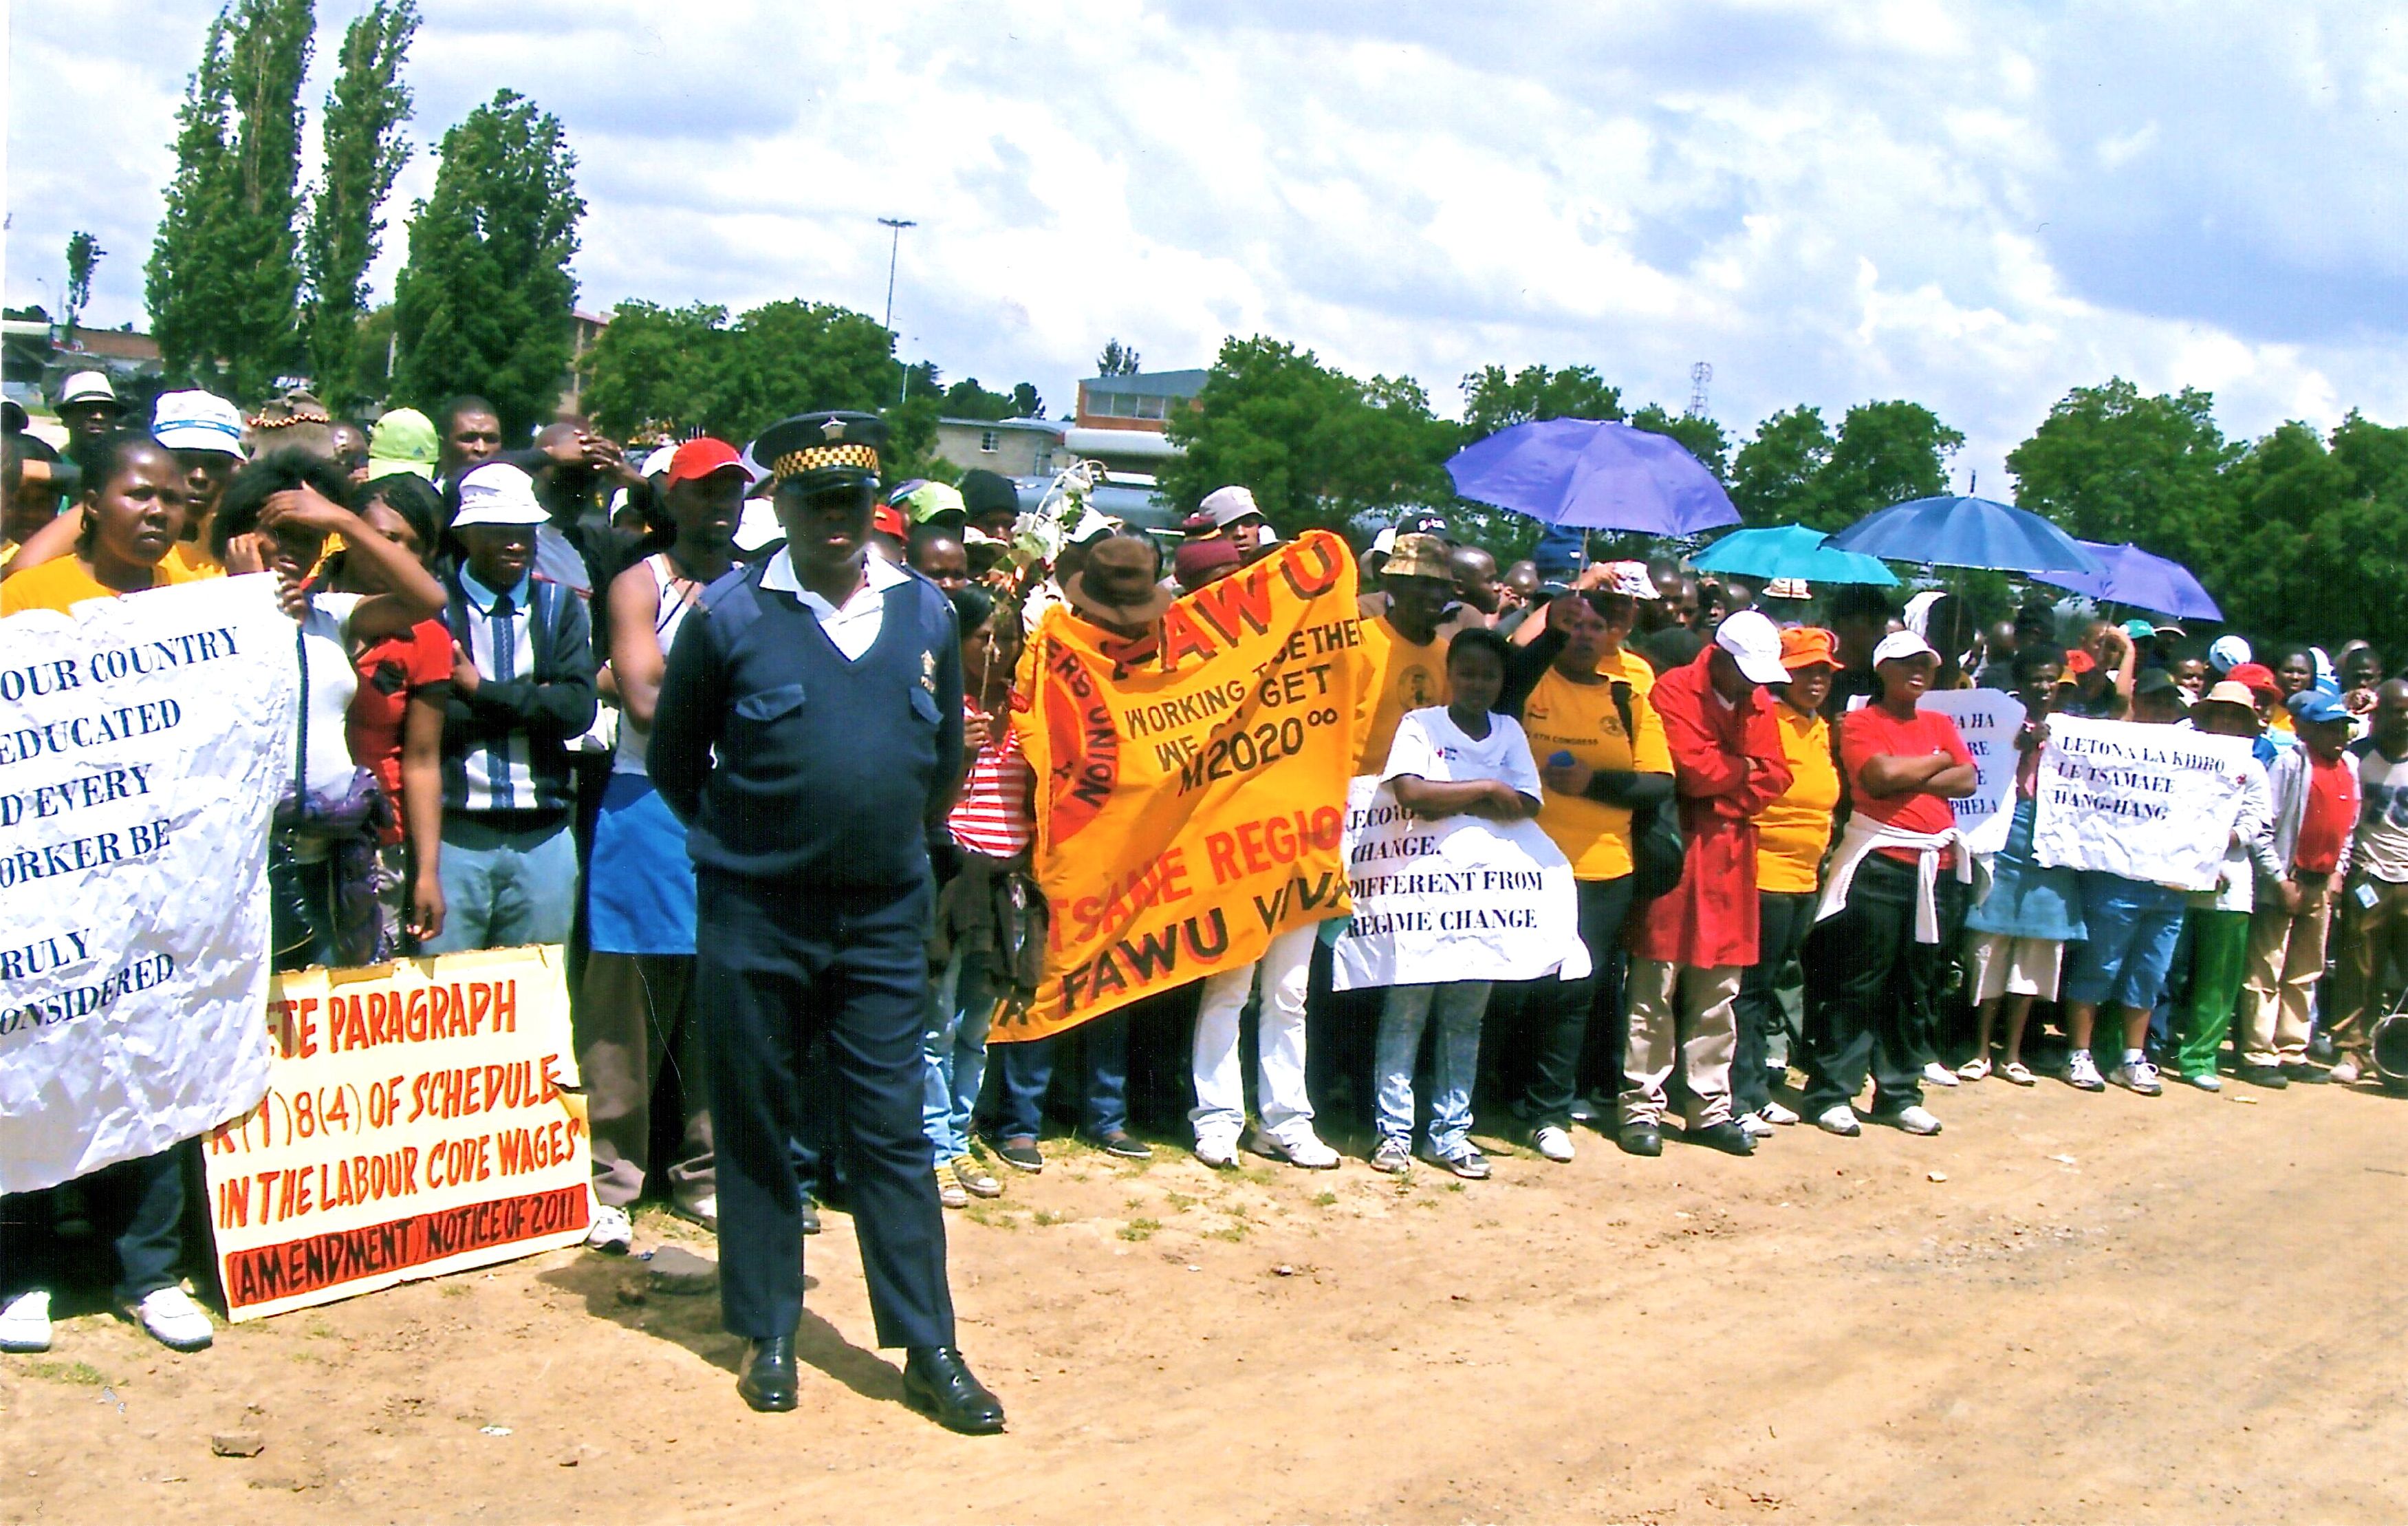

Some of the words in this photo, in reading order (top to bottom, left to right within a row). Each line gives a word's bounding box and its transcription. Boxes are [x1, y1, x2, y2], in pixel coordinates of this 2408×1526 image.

[0, 658, 81, 702] OUR
[90, 626, 240, 683] COUNTRY
[1259, 663, 1332, 708] GET
[0, 698, 181, 766] EDUCATED
[1125, 680, 1246, 740] WORKING
[1971, 713, 1995, 729] HA
[1072, 705, 1118, 808] UNION
[1967, 740, 1990, 756] RE
[2057, 761, 2081, 779] LE
[34, 764, 153, 819] EVERY
[0, 831, 122, 888] ORKER
[129, 819, 171, 855] BE
[1483, 870, 1544, 892] FROM
[0, 927, 90, 980] RULY
[1346, 911, 1433, 938] REGIME
[1440, 909, 1539, 931] CHANGE
[1058, 906, 1230, 1018] FAWU
[0, 953, 175, 1036] ONSIDERED
[329, 979, 517, 1055] PARAGRAPH
[369, 1075, 405, 1130] OF
[407, 1053, 563, 1124] SCHEDULE
[219, 1174, 250, 1229] IN
[257, 1165, 314, 1226] THE
[320, 1146, 417, 1212] LABOUR
[426, 1135, 490, 1190] CODE
[497, 1117, 581, 1176] WAGES
[425, 1199, 500, 1256] NOTICE
[504, 1198, 526, 1238] OF
[530, 1192, 576, 1232] 2011
